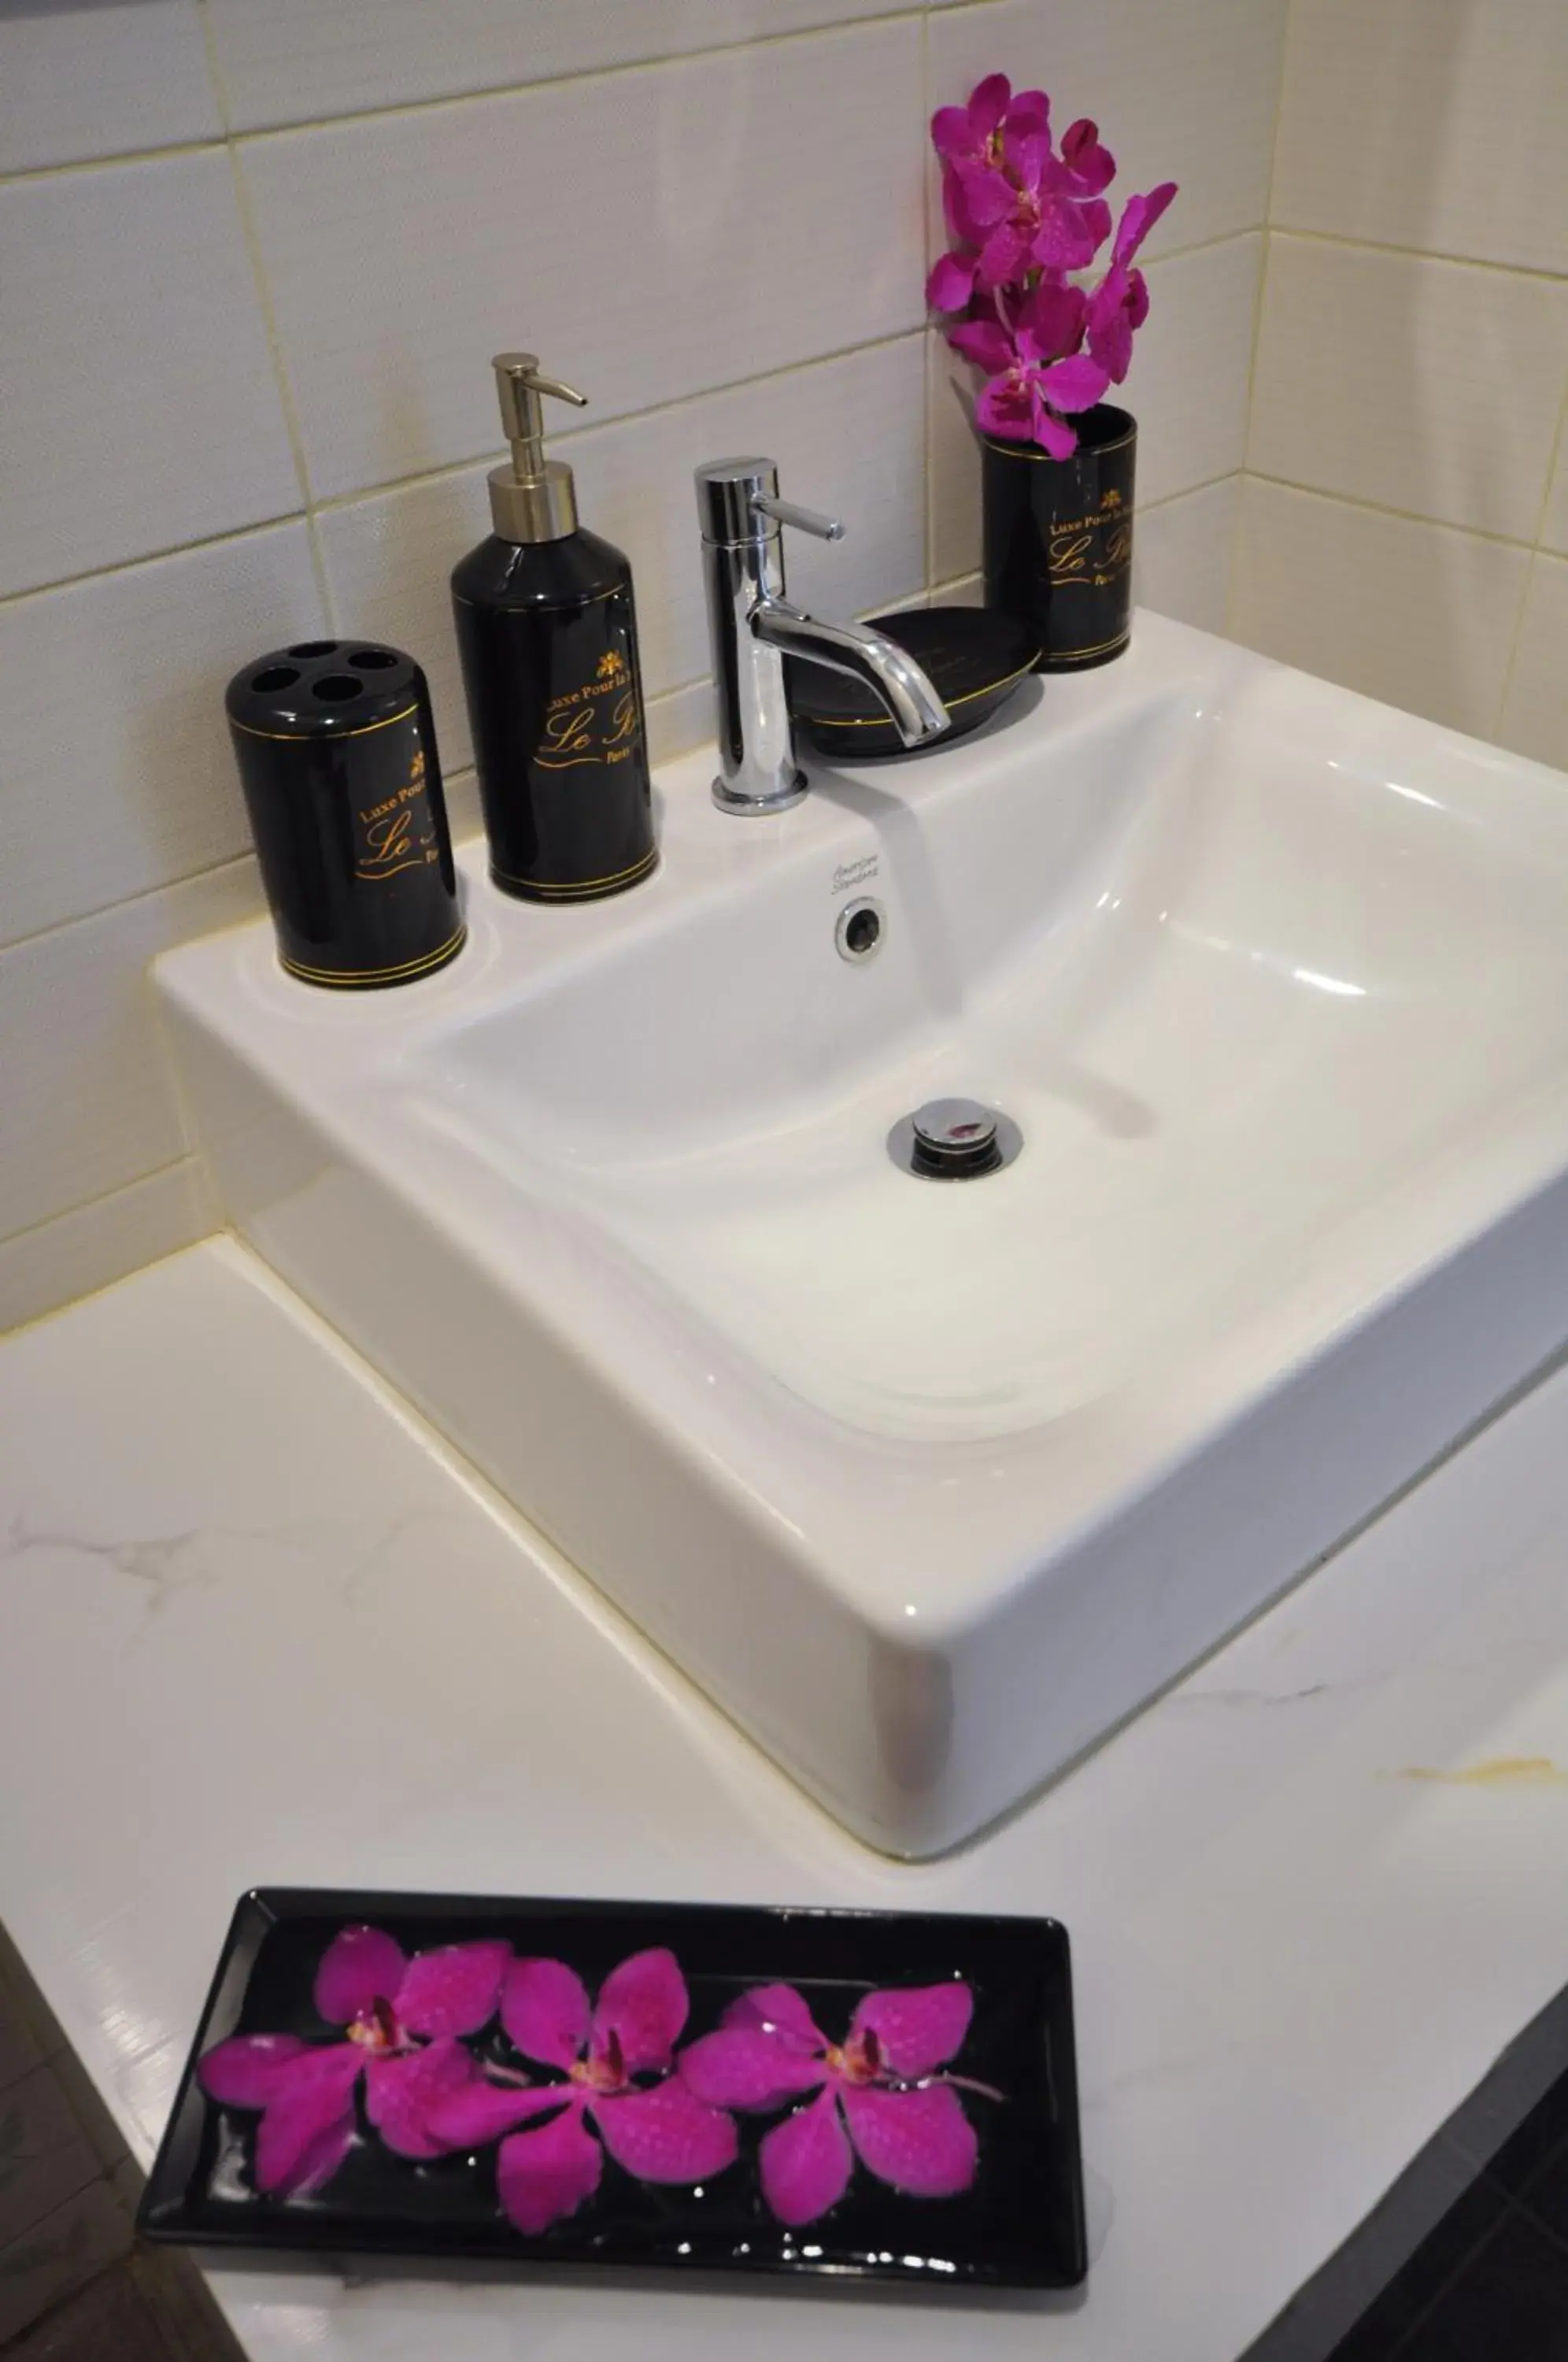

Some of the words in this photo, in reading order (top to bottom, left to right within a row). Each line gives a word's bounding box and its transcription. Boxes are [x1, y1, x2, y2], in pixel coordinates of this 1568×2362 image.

[1049, 521, 1082, 536] Luxe
[1049, 535, 1093, 572] Le
[580, 679, 615, 699] Pour
[539, 708, 595, 753] Le
[359, 797, 398, 824] Luxe
[359, 809, 412, 865] Le
